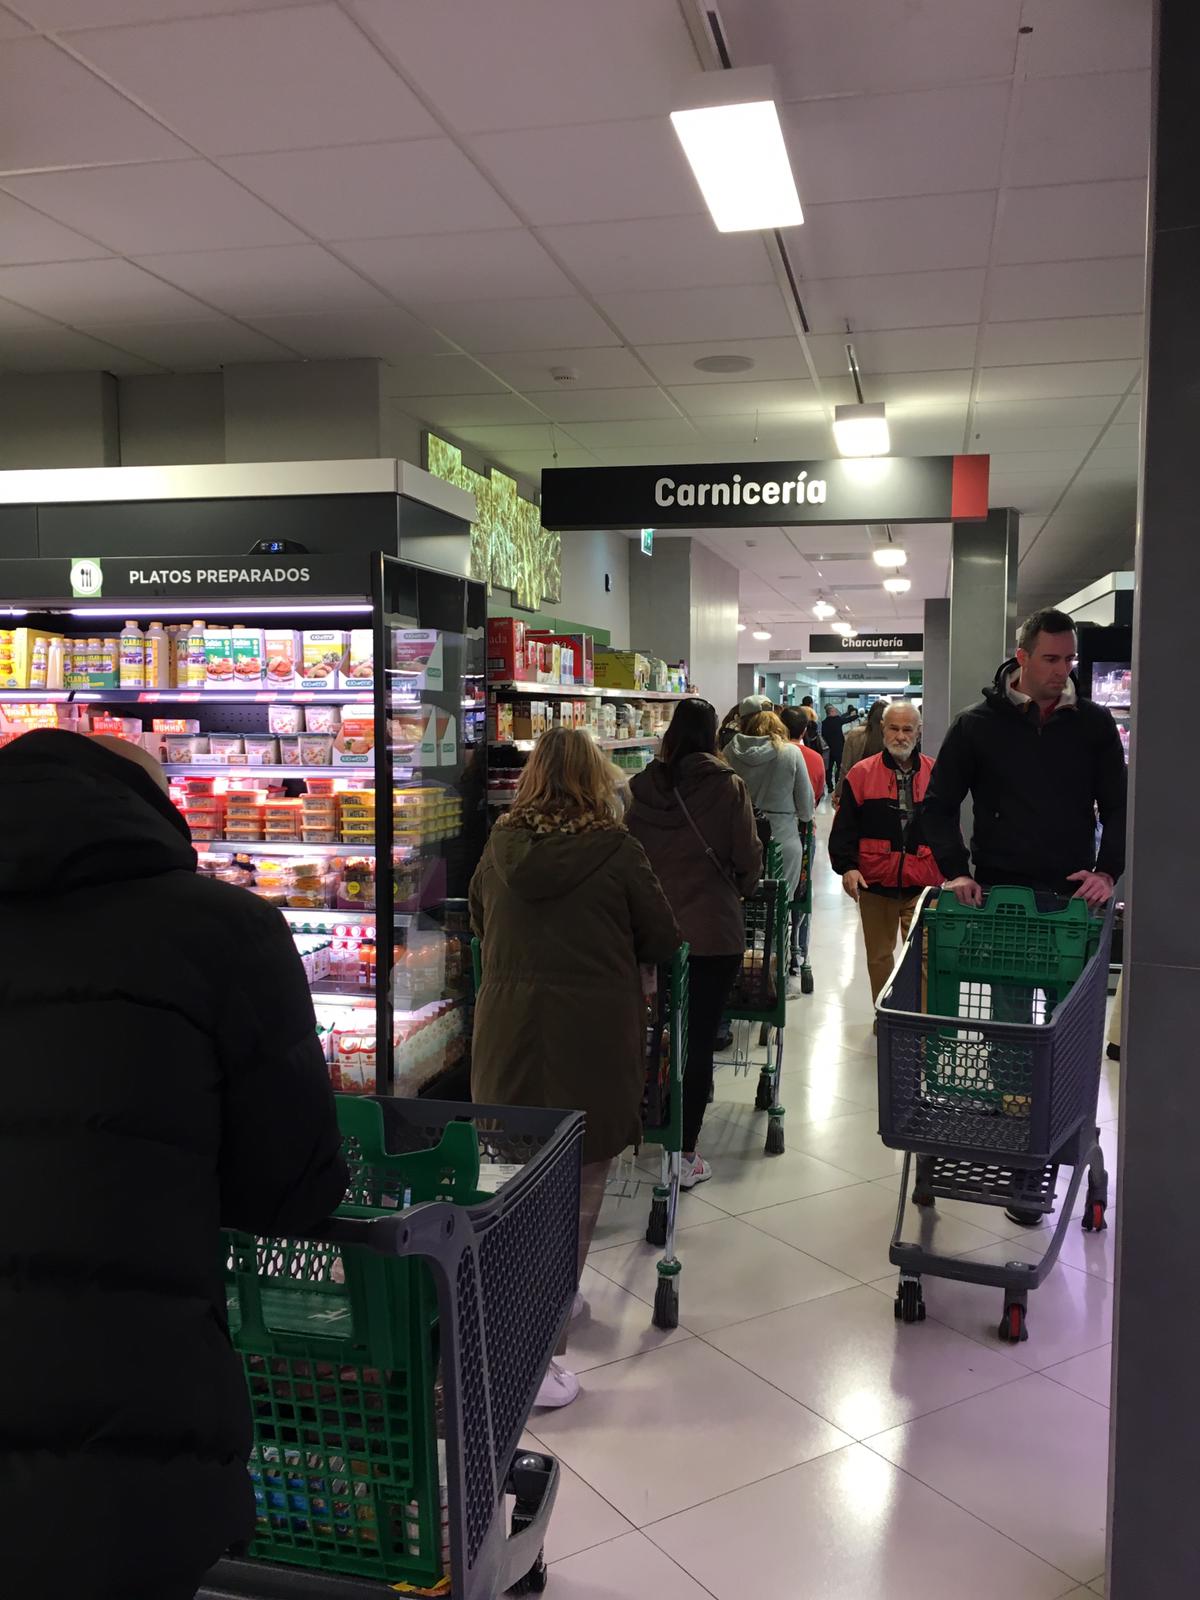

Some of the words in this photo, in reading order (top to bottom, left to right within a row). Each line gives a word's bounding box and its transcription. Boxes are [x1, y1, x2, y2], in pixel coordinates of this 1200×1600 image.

[655, 471, 827, 507] Carnicería
[129, 570, 192, 584] PLATOS
[196, 568, 310, 583] PREPARADOS
[841, 637, 903, 648] Charcutería
